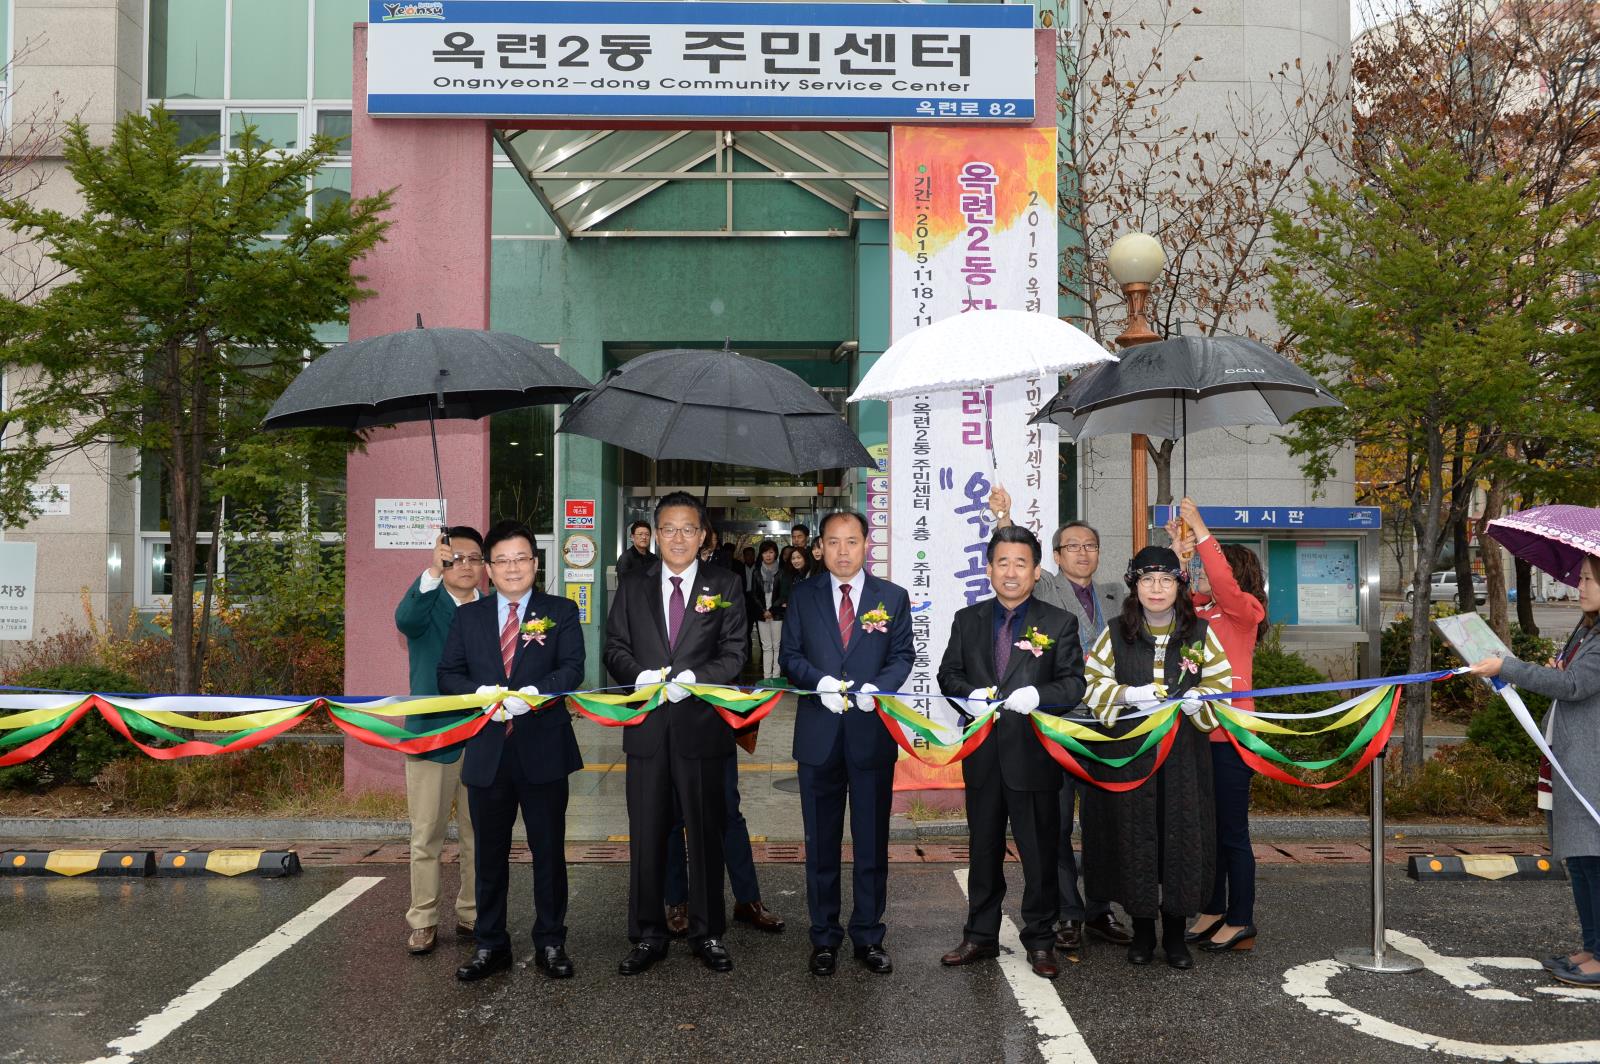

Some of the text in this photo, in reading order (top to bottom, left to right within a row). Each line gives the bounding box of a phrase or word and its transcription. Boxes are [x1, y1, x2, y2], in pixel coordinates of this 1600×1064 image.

[384, 3, 443, 17] Yeonsu
[432, 31, 971, 76] 옥련2동 주민센터
[433, 76, 970, 92] Ongnyeon2-dong Community Service Center
[916, 100, 1016, 116] 옥련로 82
[960, 164, 996, 286] 옥련2동
[1028, 190, 1038, 268] 2015
[912, 403, 932, 541] 옥련2동 주민센터 4층
[912, 615, 931, 668] 옥련2동
